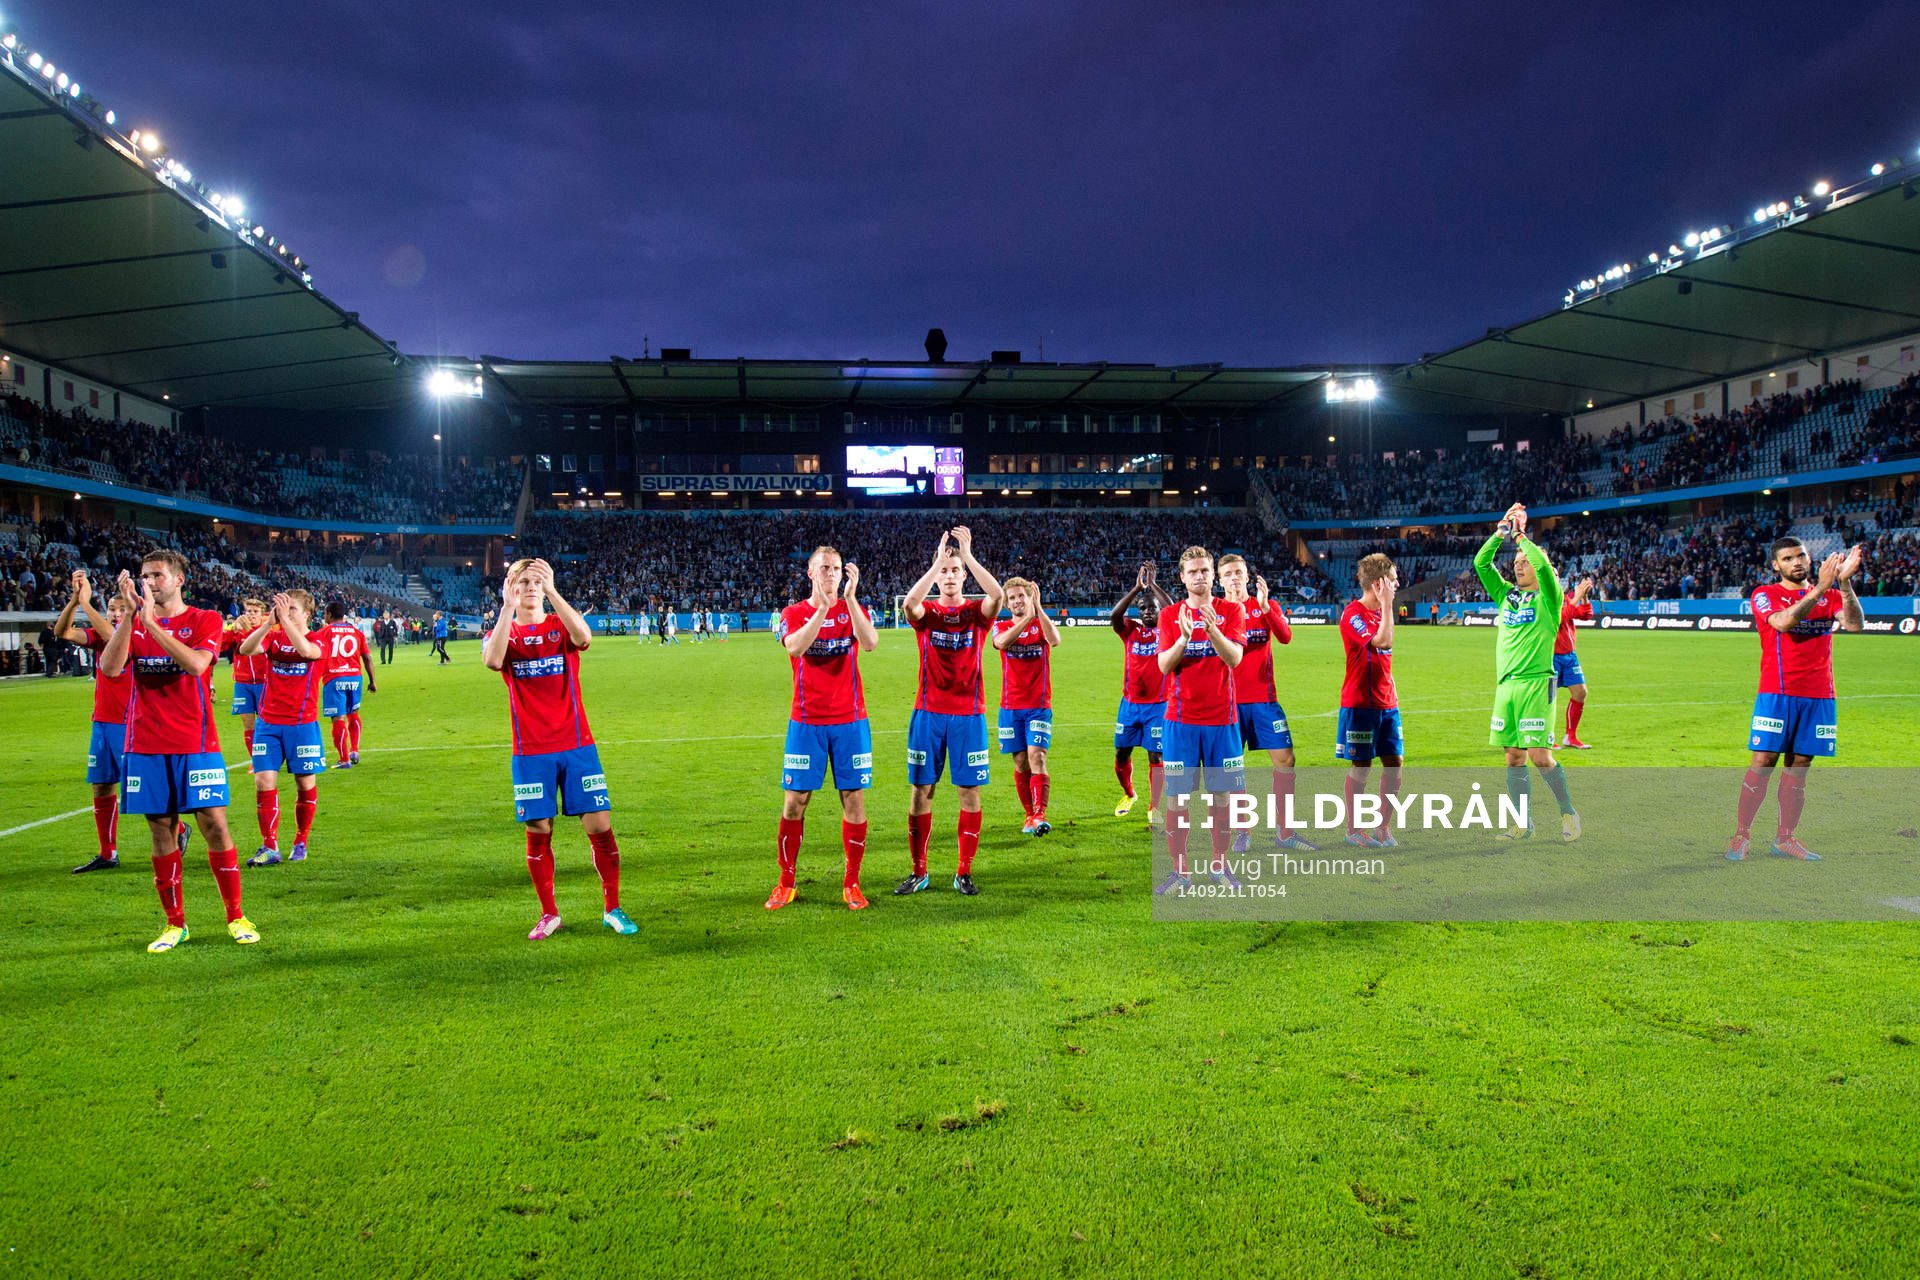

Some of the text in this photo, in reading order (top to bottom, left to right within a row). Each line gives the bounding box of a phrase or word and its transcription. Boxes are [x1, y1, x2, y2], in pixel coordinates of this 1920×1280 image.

[642, 476, 729, 490] SUPRAS
[994, 475, 1135, 488] MFF SUPPORT
[1650, 602, 1680, 615] JMS
[1796, 620, 1832, 628] SURS
[1247, 630, 1267, 638] URS
[331, 634, 358, 658] 10
[1187, 642, 1211, 650] ESU
[137, 658, 174, 666] RESU
[1757, 719, 1783, 729] SOLID
[303, 761, 313, 770] 28
[976, 770, 987, 780] 29
[198, 788, 211, 800] 16
[517, 786, 542, 795] SOLID
[594, 795, 604, 806] 15
